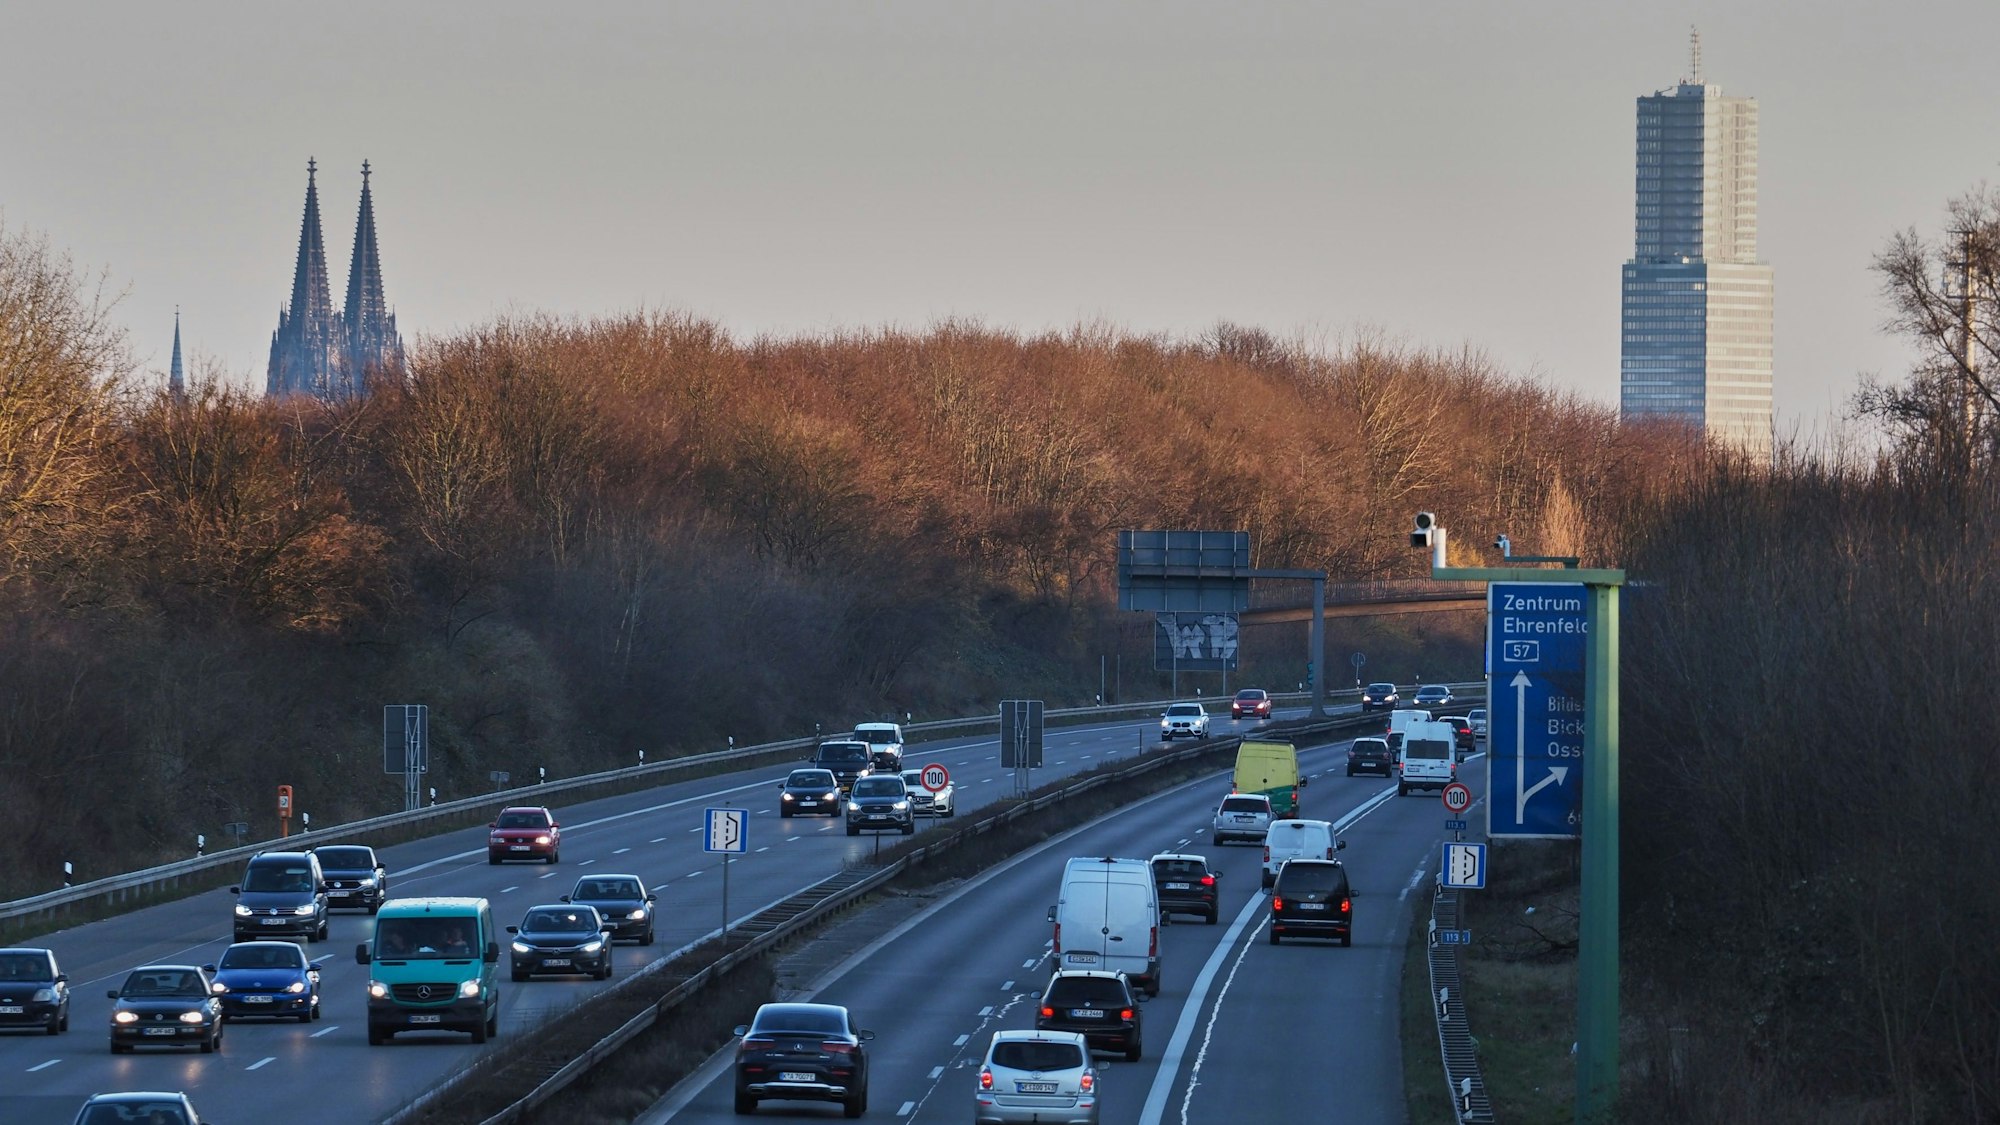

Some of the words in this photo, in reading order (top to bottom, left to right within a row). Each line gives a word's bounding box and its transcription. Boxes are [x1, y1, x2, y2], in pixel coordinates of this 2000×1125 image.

[1504, 594, 1581, 611] Zentrum
[1513, 644, 1530, 658] 57
[1548, 696, 1585, 712] Bilde
[1548, 742, 1585, 757] Oss
[926, 771, 943, 785] 100
[1448, 791, 1465, 805] 100
